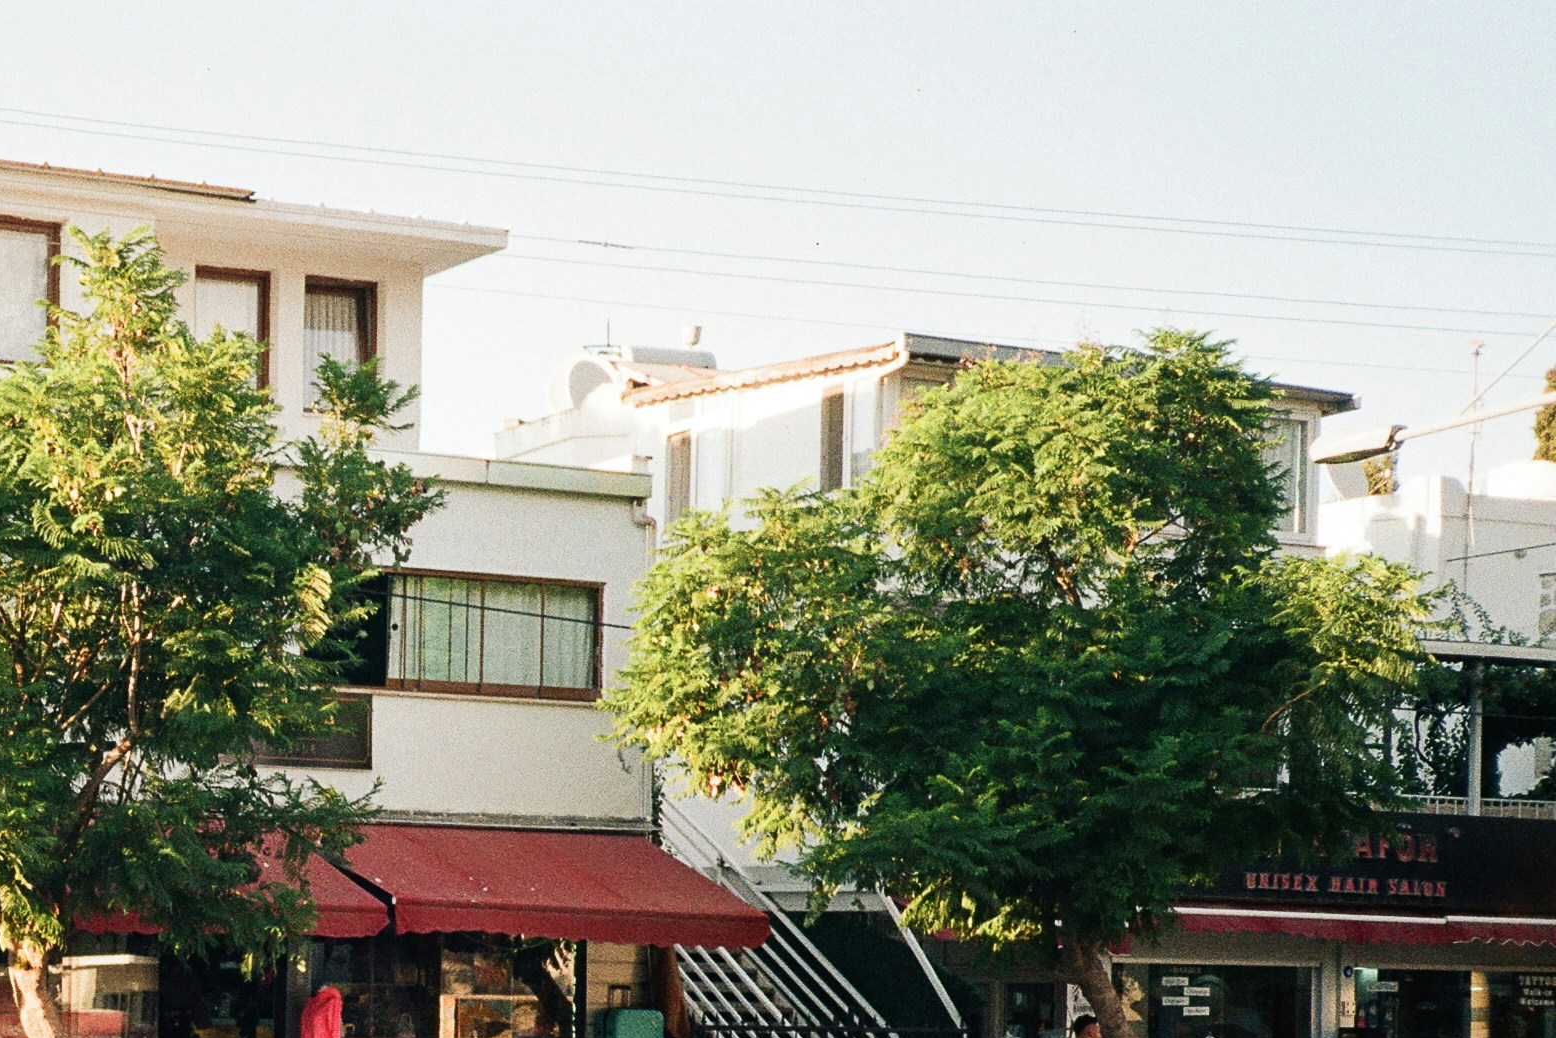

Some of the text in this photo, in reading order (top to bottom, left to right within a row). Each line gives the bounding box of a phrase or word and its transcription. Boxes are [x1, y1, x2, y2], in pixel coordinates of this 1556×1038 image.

[1245, 872, 1447, 897] UNISEX HAIR SALON
